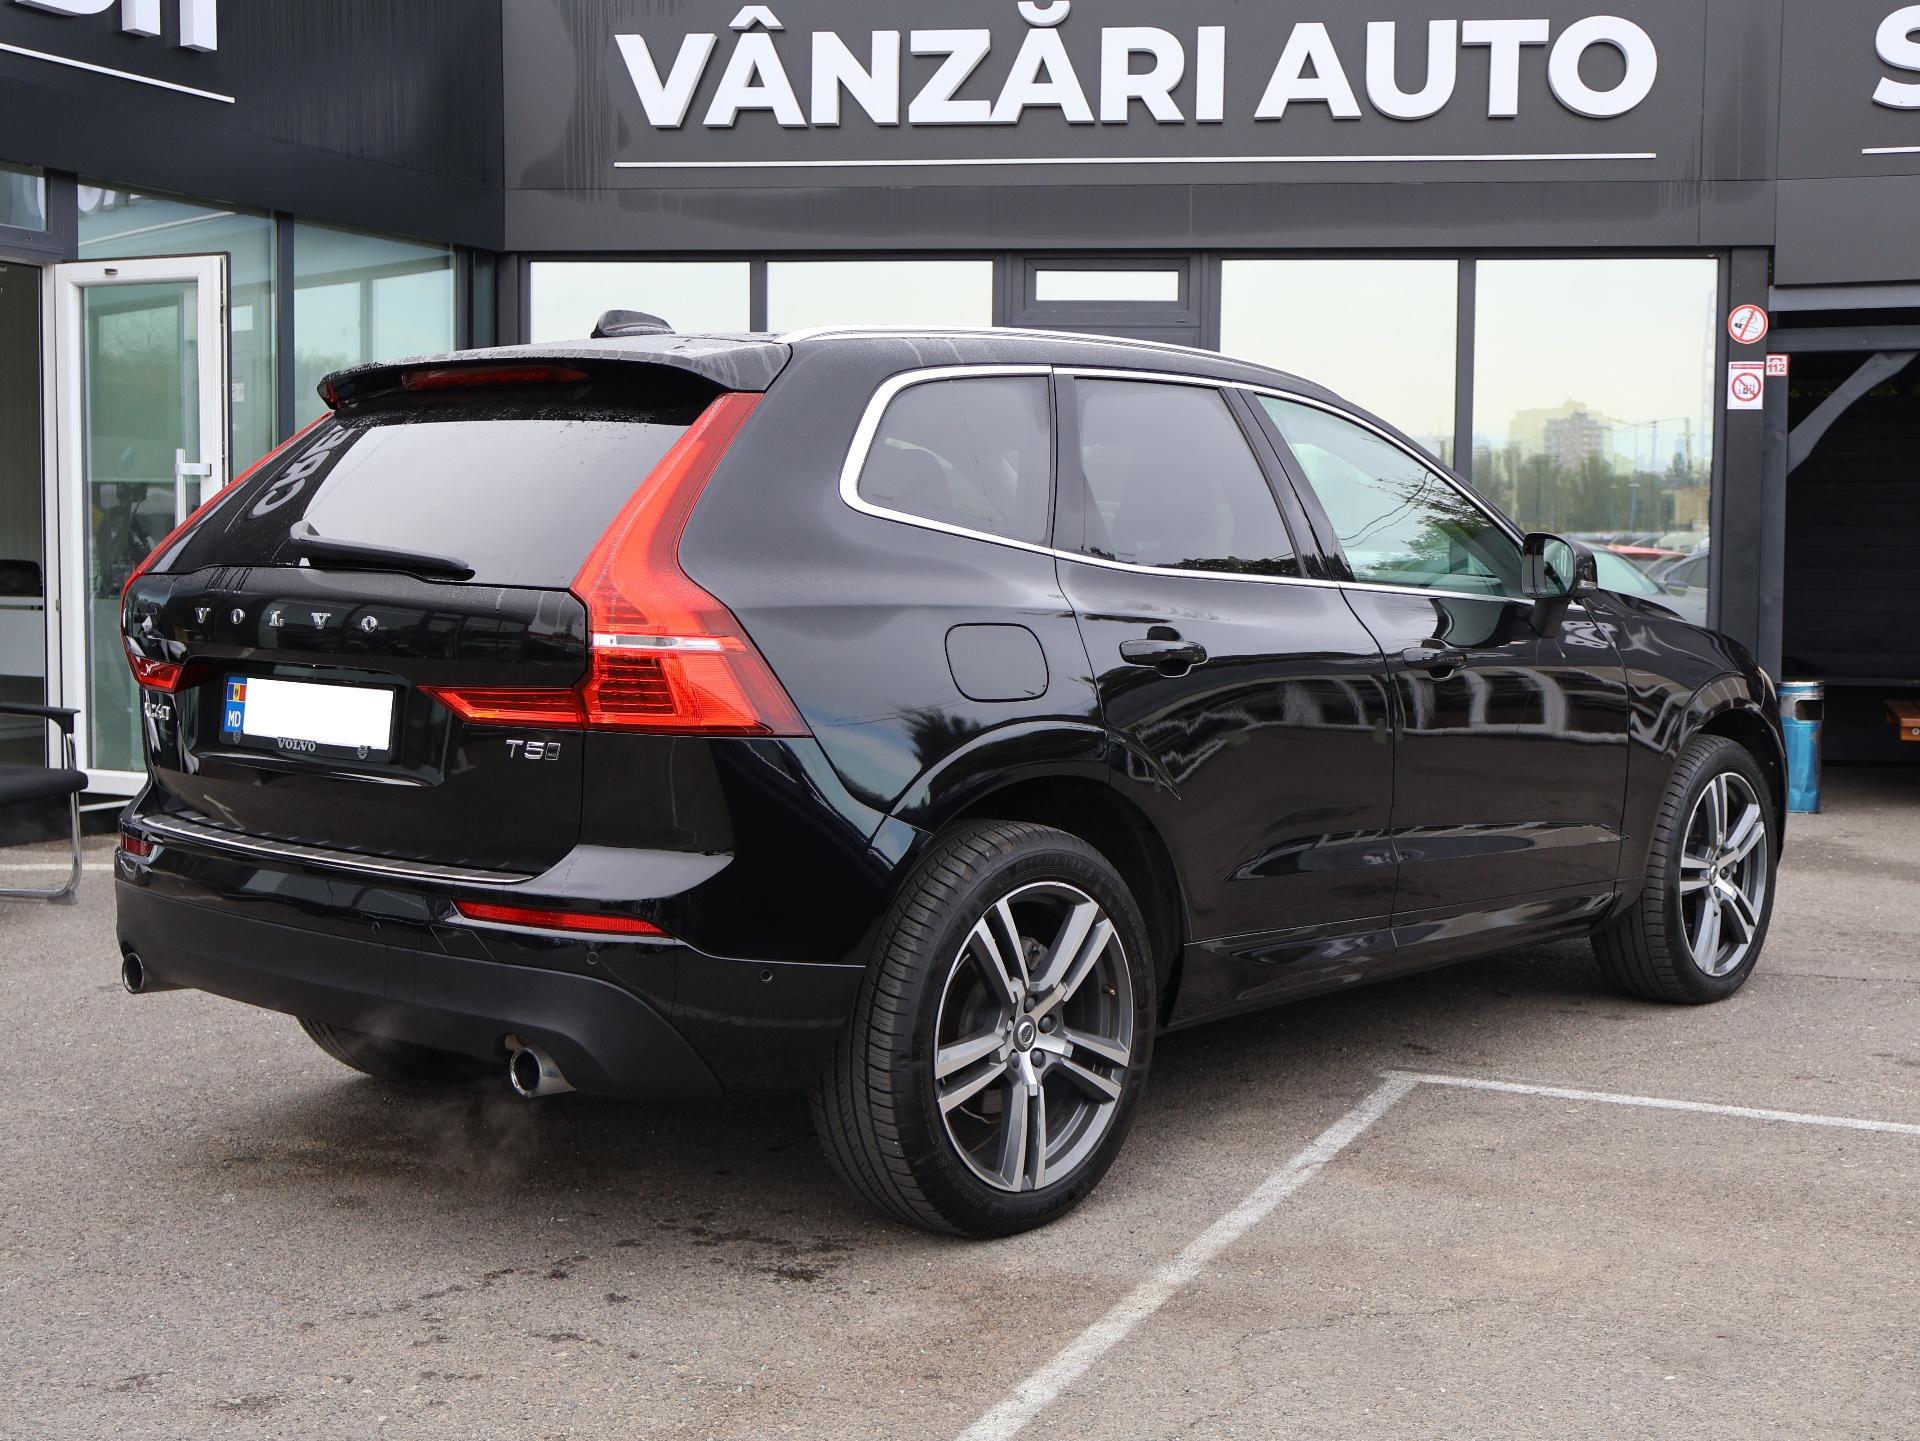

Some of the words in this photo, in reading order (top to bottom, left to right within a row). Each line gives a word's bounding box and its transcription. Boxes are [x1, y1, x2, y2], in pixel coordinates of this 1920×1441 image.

[614, 0, 1226, 128] VÂNZĂRI
[1254, 15, 1657, 120] AUTO
[1767, 363, 1785, 372] 112
[195, 607, 379, 633] VOLVO
[228, 710, 241, 728] MD
[276, 736, 317, 752] VOLVO
[506, 740, 545, 759] T5
